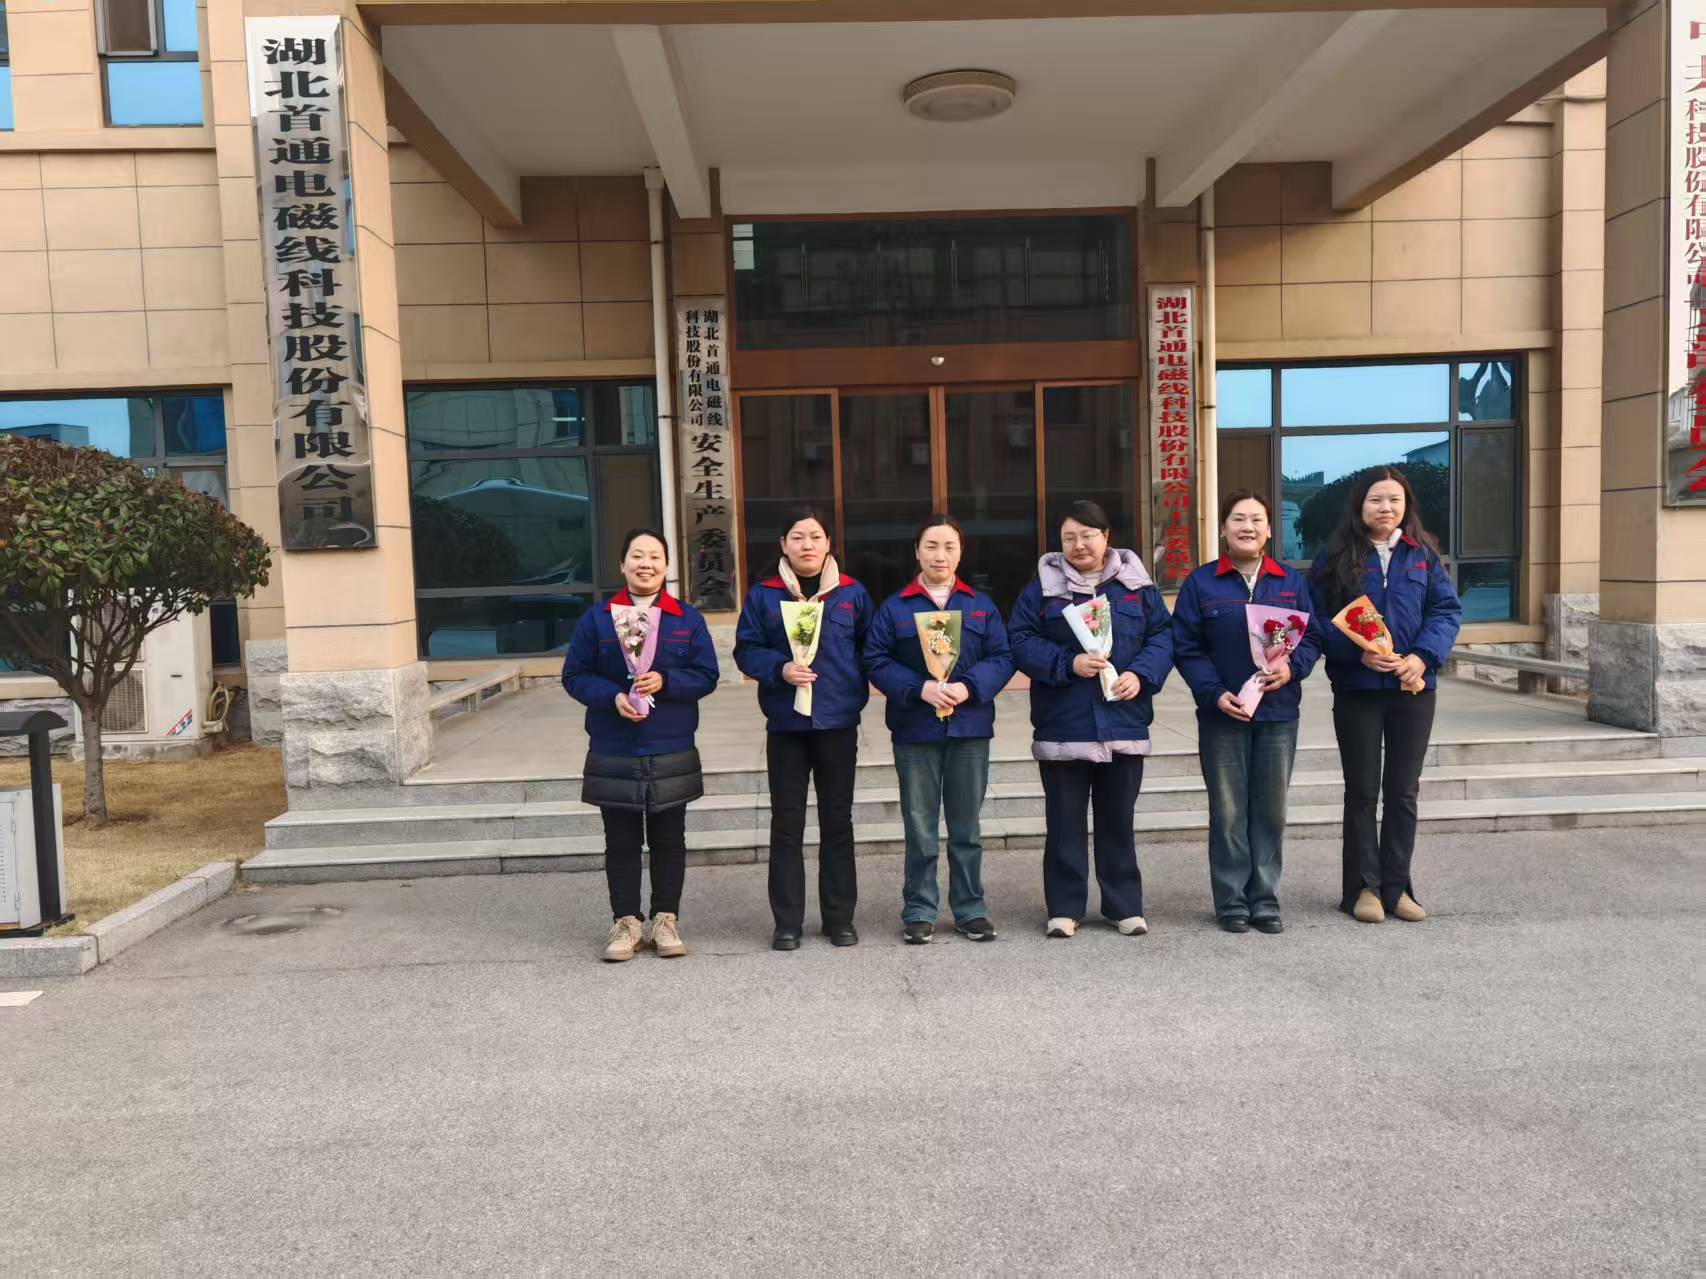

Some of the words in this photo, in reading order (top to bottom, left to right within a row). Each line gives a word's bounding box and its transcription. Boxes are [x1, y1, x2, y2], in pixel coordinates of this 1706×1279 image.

[262, 37, 355, 522] 湖北首通电磁线科技股份有限公司
[685, 310, 703, 426] 科技股份有限公司
[703, 310, 723, 426] 湖北首通电磁线
[690, 432, 729, 596] 安全生产委员会
